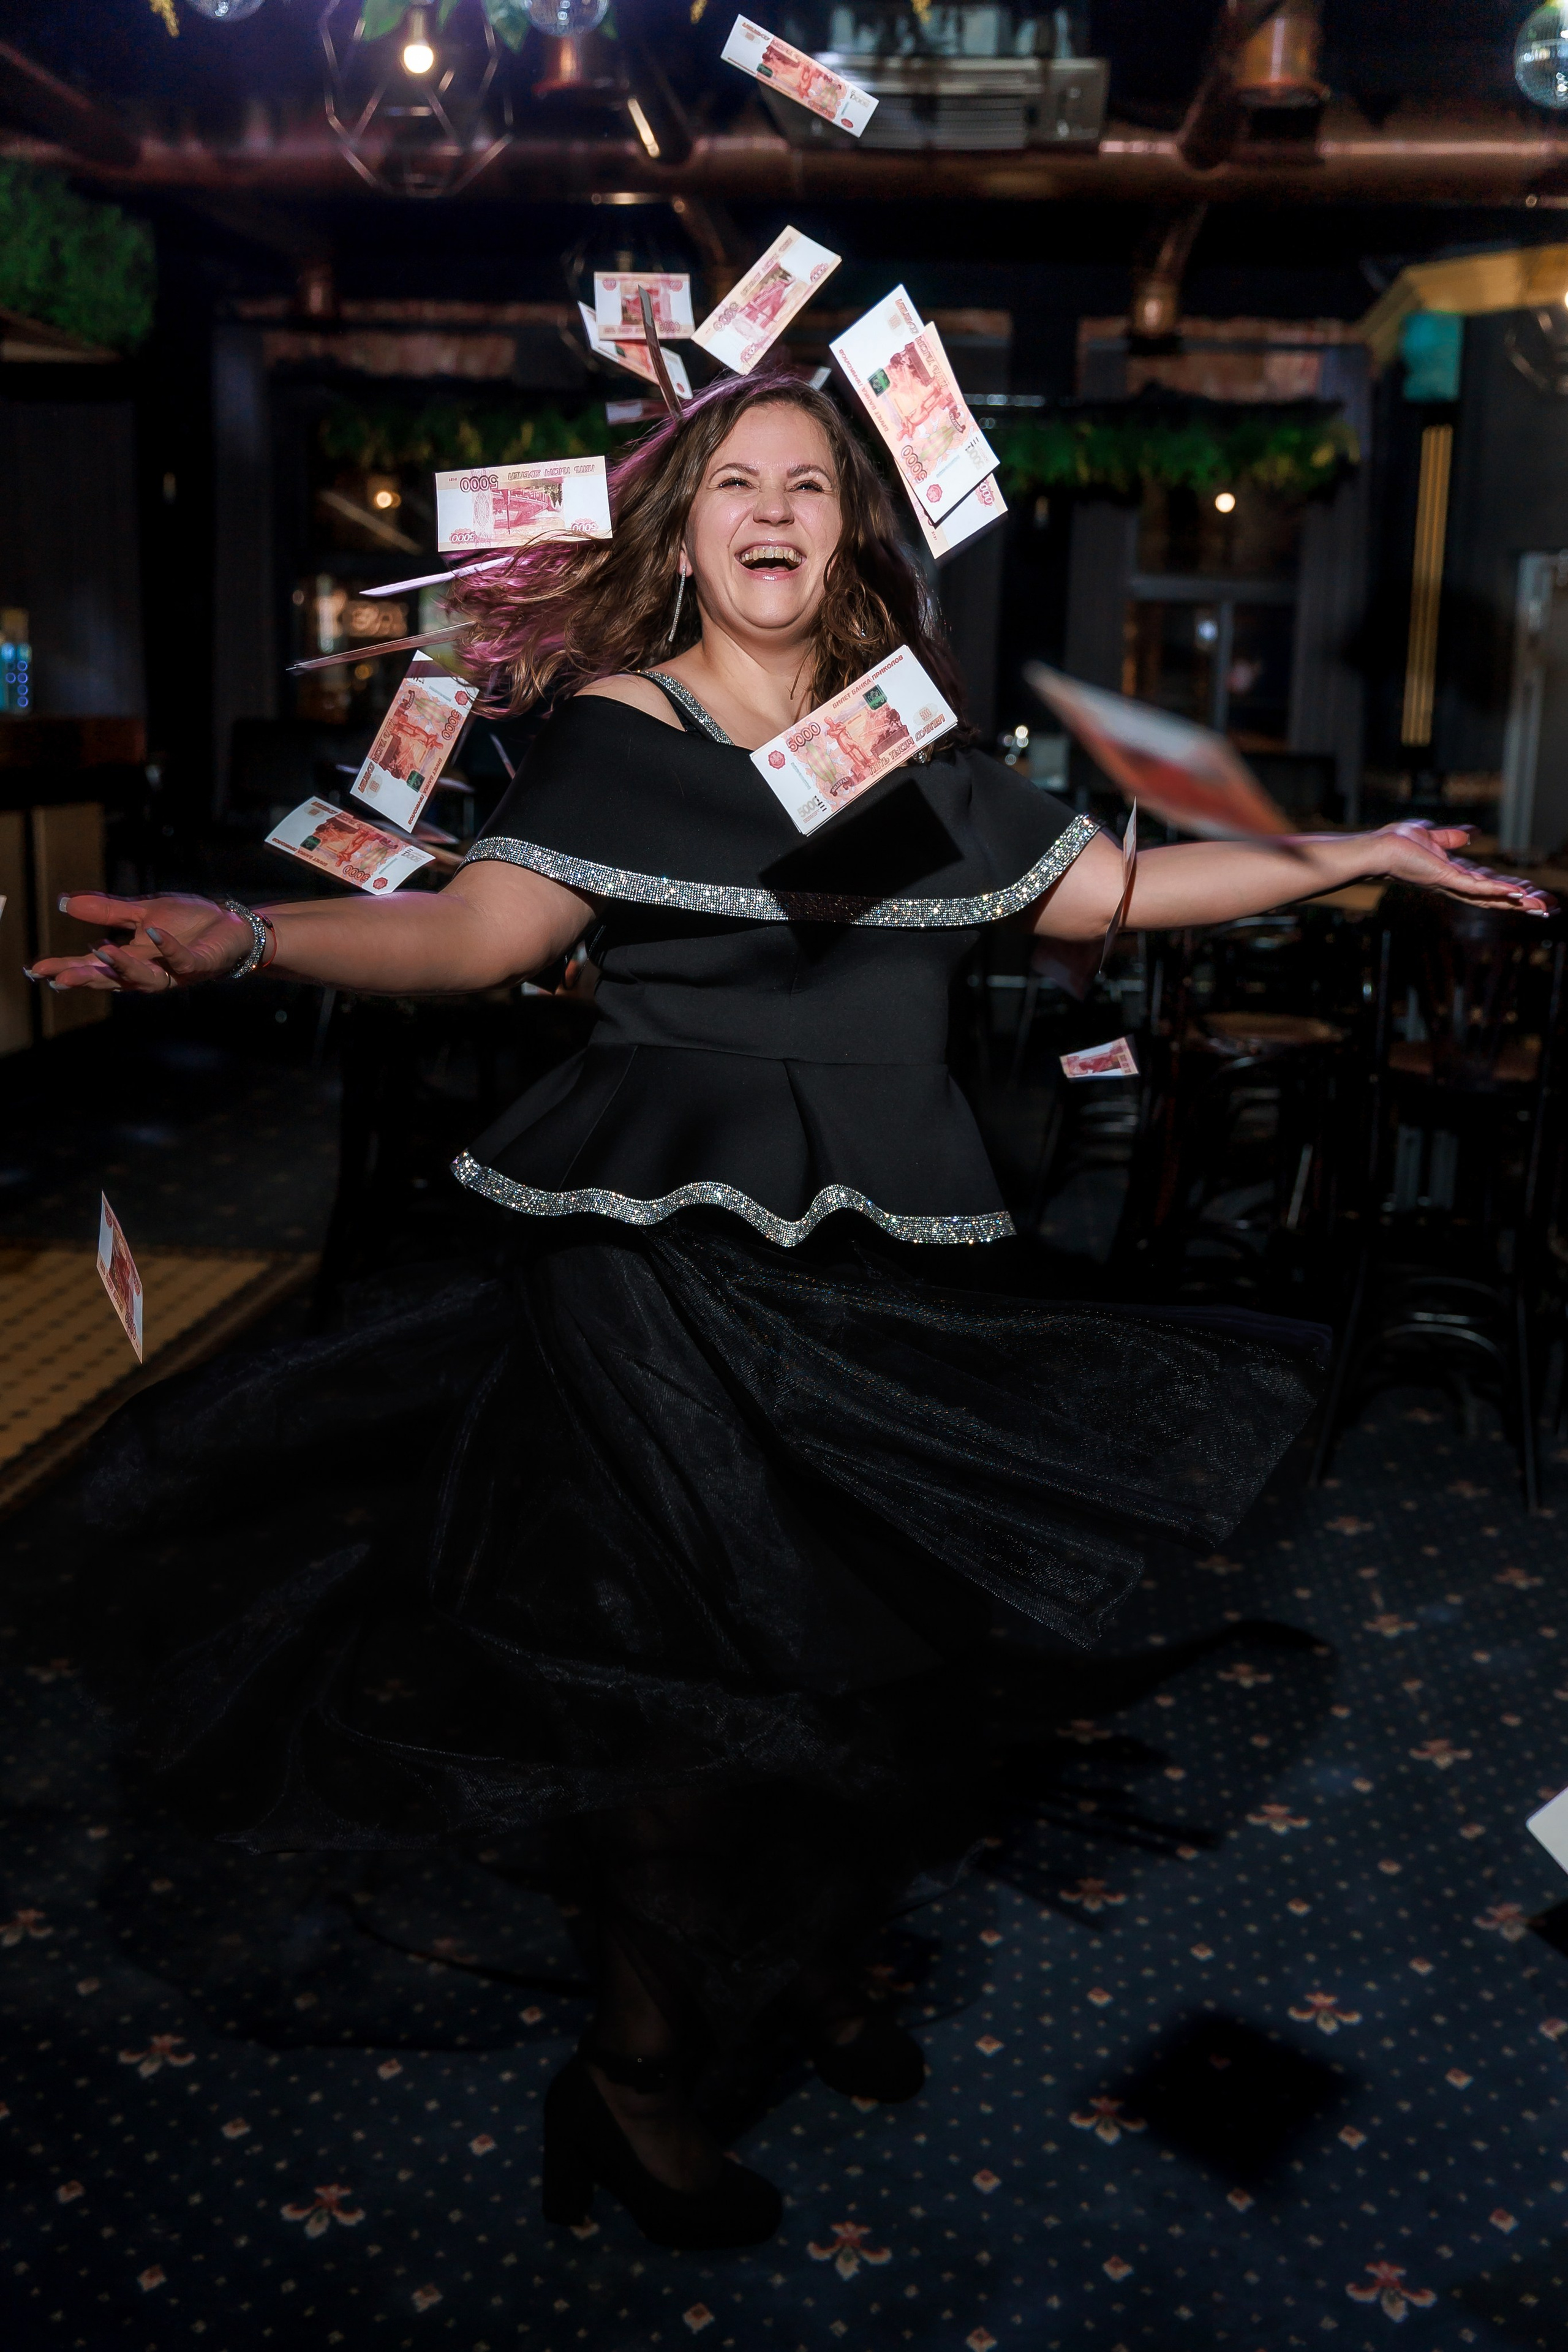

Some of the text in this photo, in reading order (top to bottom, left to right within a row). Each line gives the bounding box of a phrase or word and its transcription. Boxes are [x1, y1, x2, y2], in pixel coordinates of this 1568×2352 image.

[839, 349, 863, 386] ПРИКОЛОВ
[545, 466, 571, 476] ТЫСЯЧ
[574, 464, 595, 473] ПЯТЬ
[901, 445, 928, 484] 5000
[459, 474, 499, 492] 5000
[451, 532, 476, 543] 5000
[832, 654, 904, 709] БИЛЕТ БАНКА ПРИКОЛОВ
[442, 709, 462, 741] 5000
[786, 722, 821, 752] 5000
[869, 714, 946, 775] ПЯТЬ ТЫСЯЧ ДУБЛЕЙ
[407, 794, 424, 825] ПРИКОЛОВ
[342, 865, 371, 883] 5000
